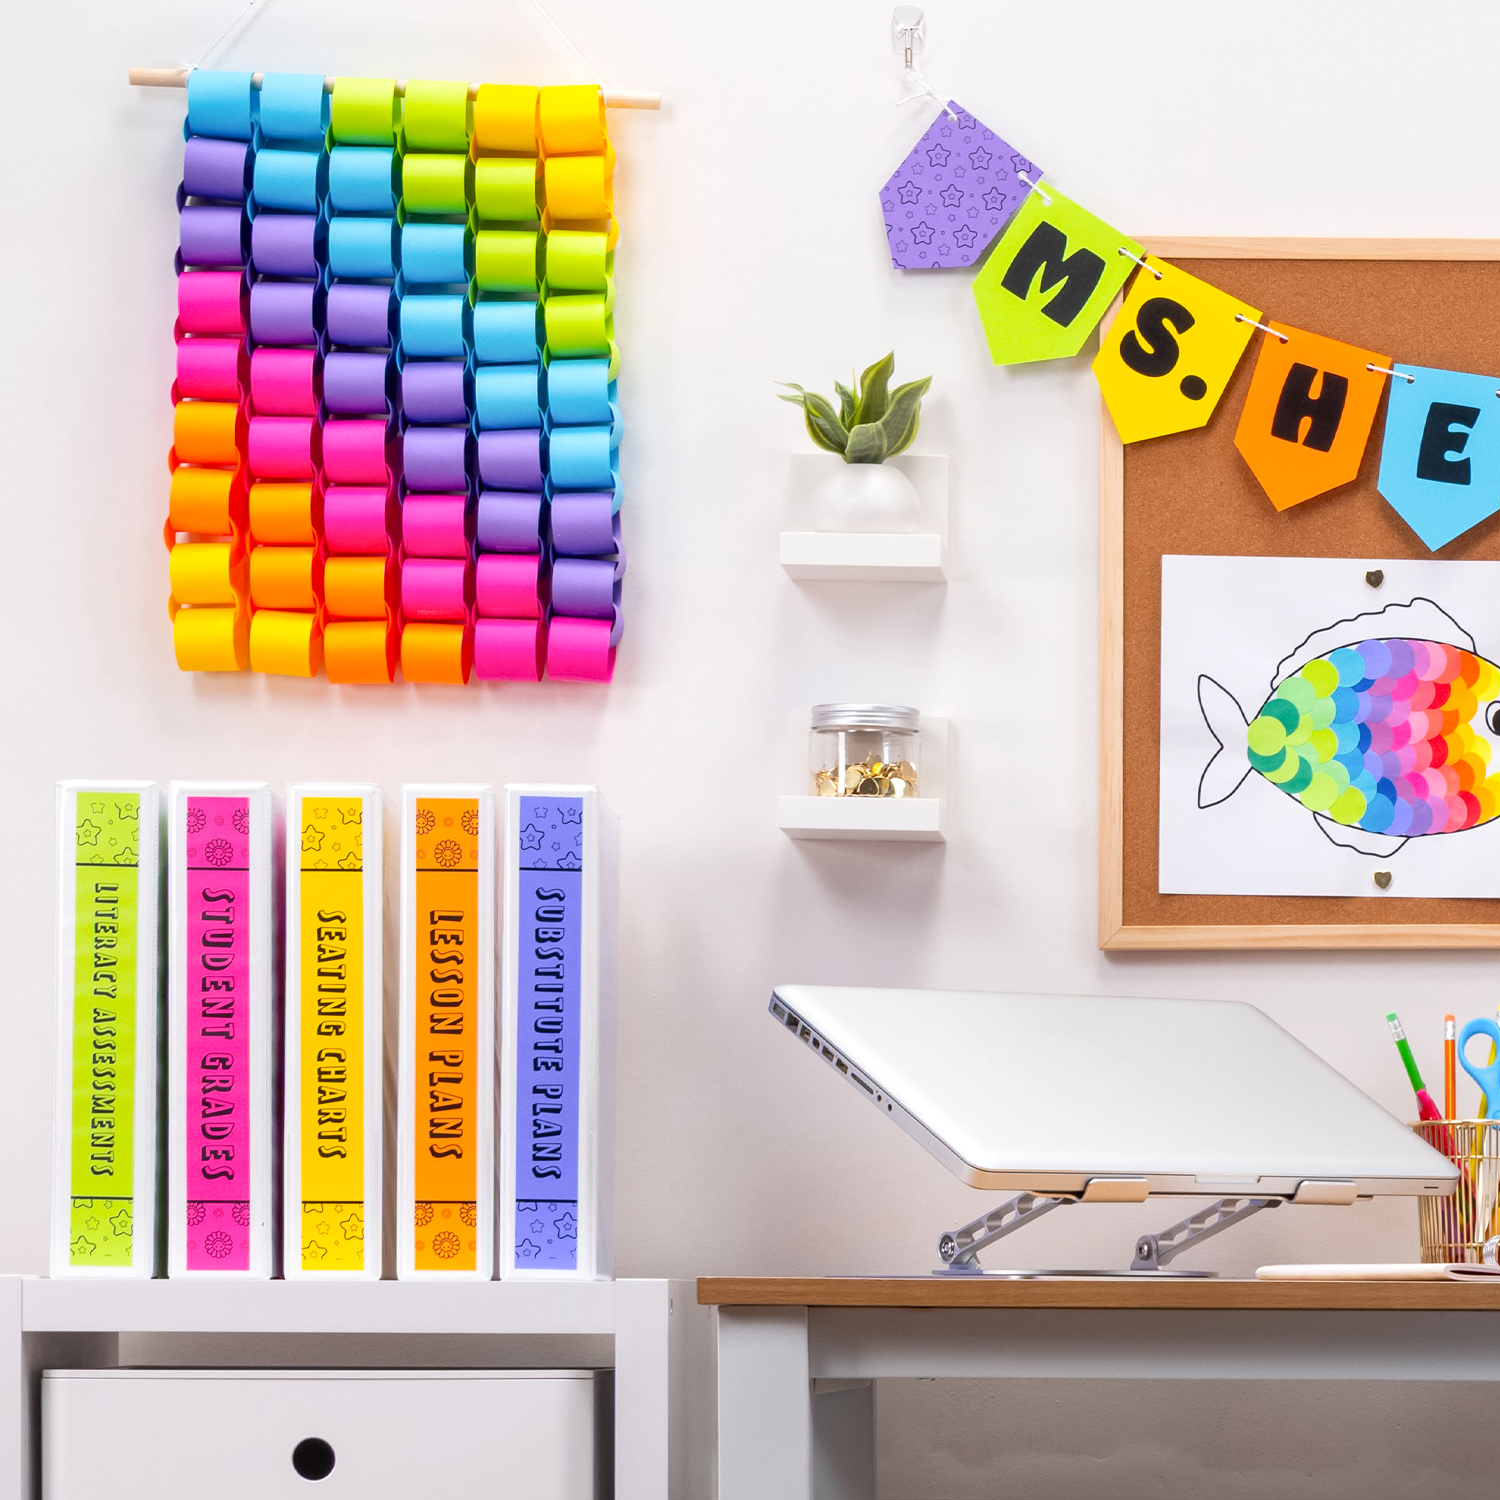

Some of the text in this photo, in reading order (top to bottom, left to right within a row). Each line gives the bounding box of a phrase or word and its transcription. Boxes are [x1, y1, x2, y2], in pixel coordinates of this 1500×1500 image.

[1001, 221, 1208, 402] MS.
[90, 881, 119, 1177] LITERACY ASSESSMENTS
[200, 886, 235, 1181] STUDENT GRADES
[316, 908, 348, 1160] SEATING CHARTS
[428, 908, 465, 1160] LESSON PLANS
[531, 886, 566, 1181] SUBSTITUTE PLANS
